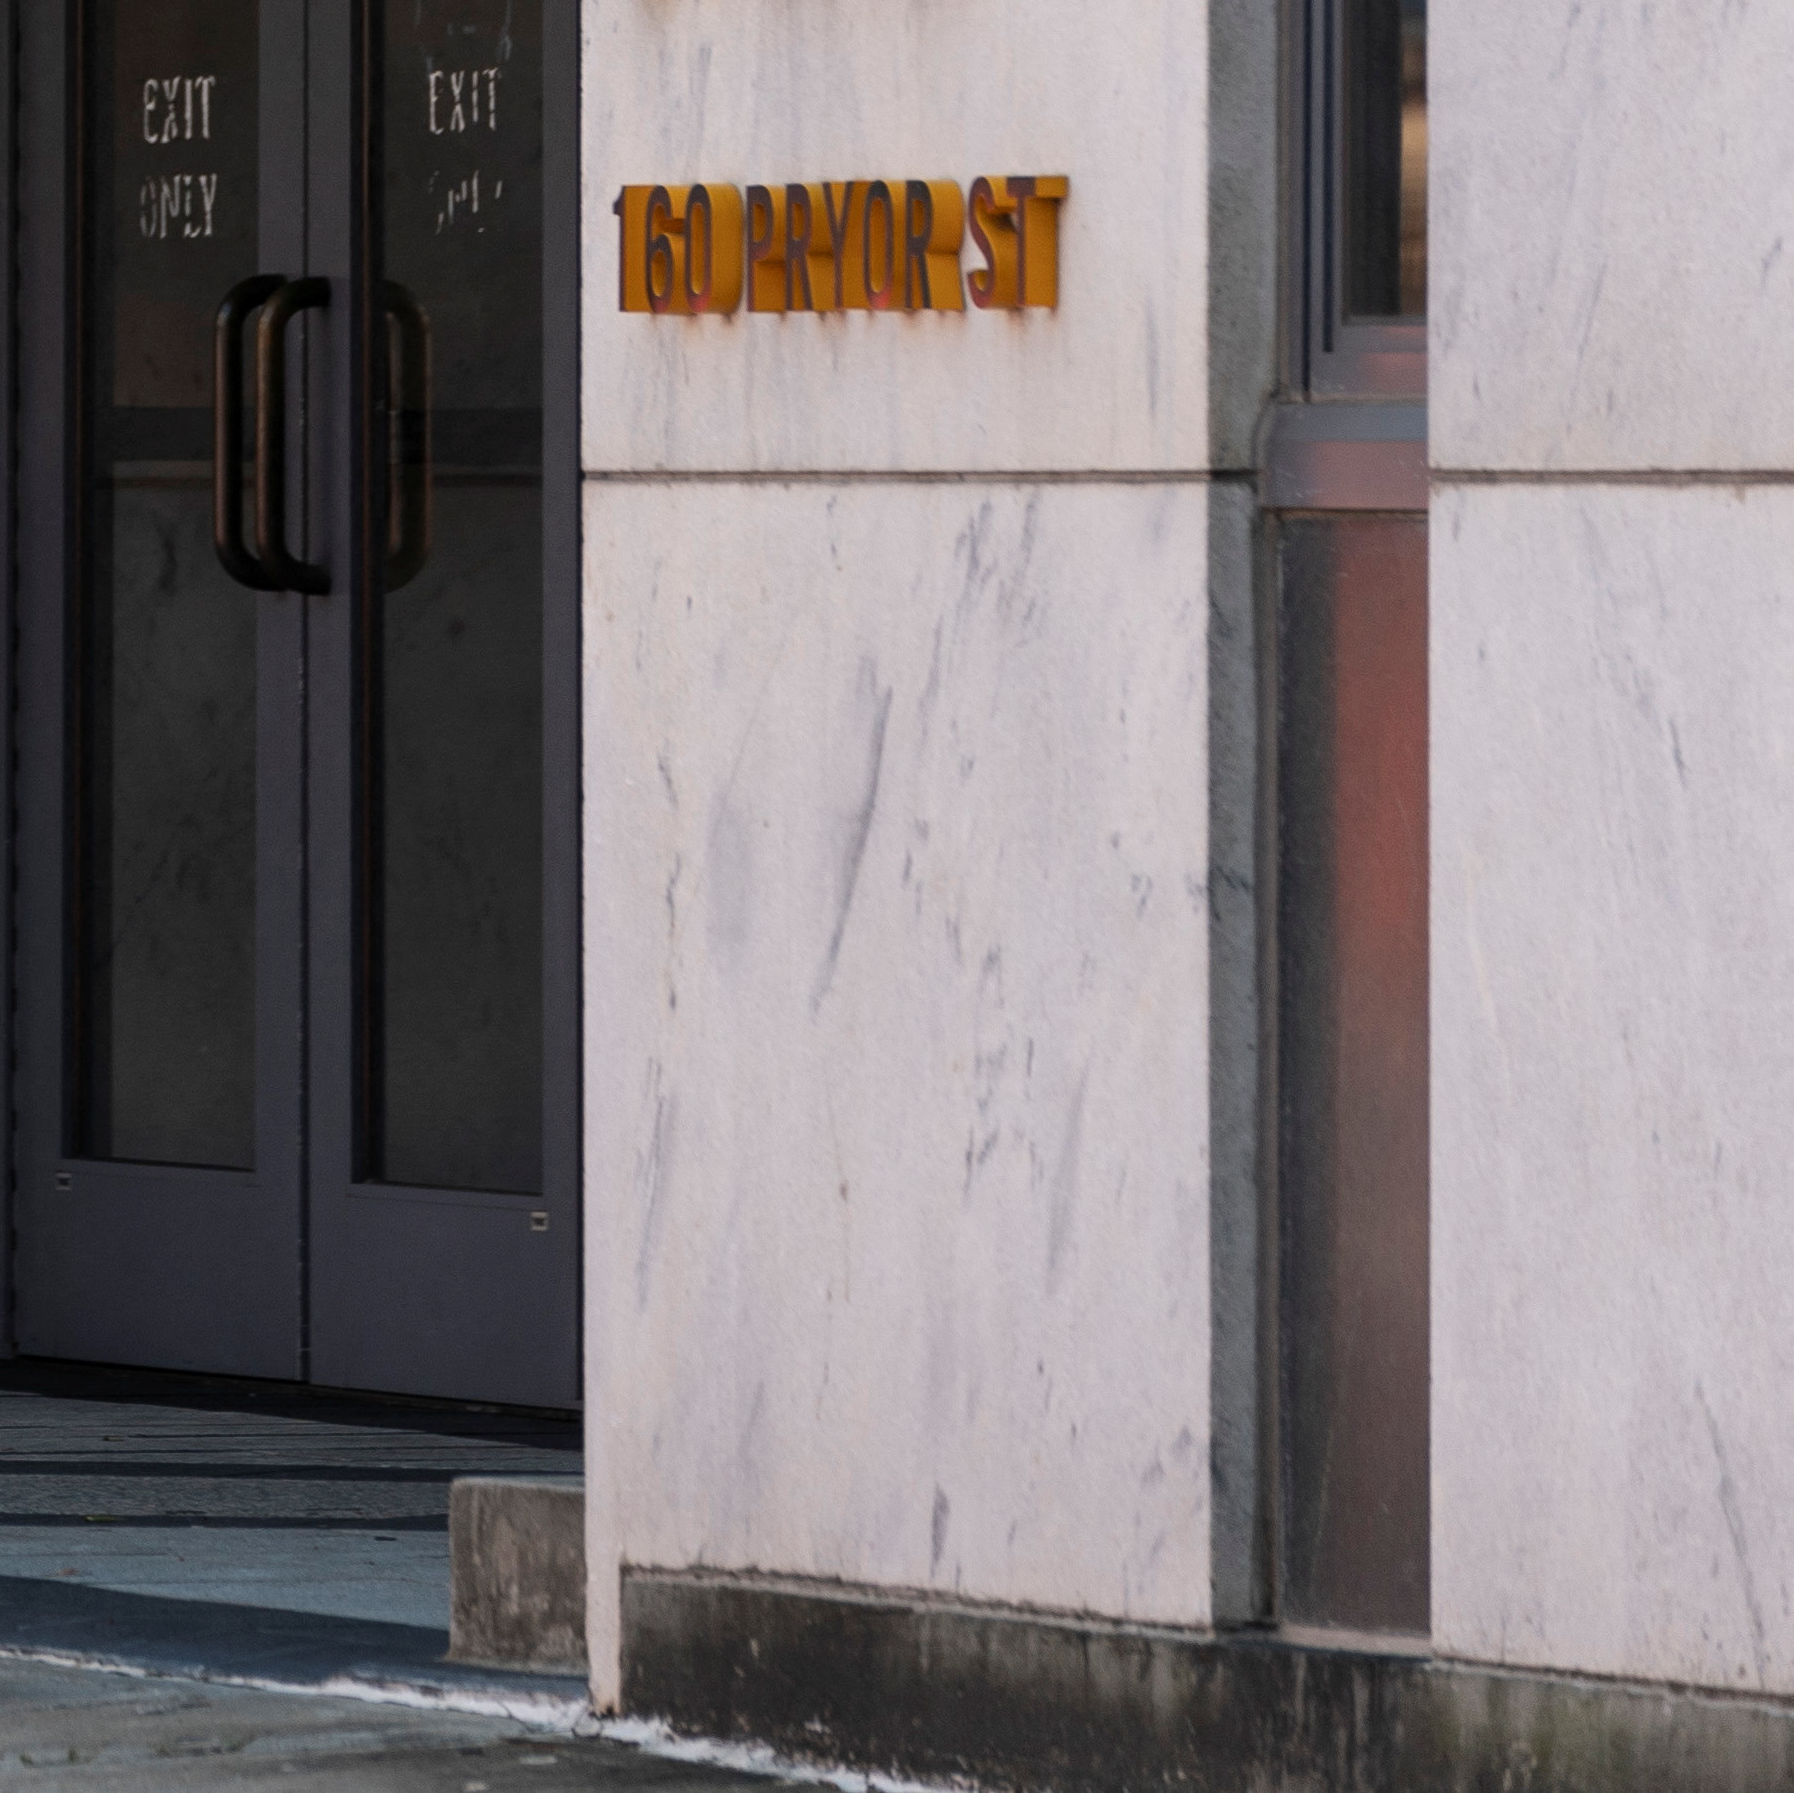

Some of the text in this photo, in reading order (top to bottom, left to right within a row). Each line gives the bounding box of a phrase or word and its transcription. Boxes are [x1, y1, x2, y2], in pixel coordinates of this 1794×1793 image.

[142, 75, 217, 144] EXIT
[429, 67, 500, 135] EXIT
[139, 173, 217, 239] ONLY
[612, 183, 743, 314] 160
[745, 180, 964, 313] PRYOR
[968, 176, 1068, 309] ST
